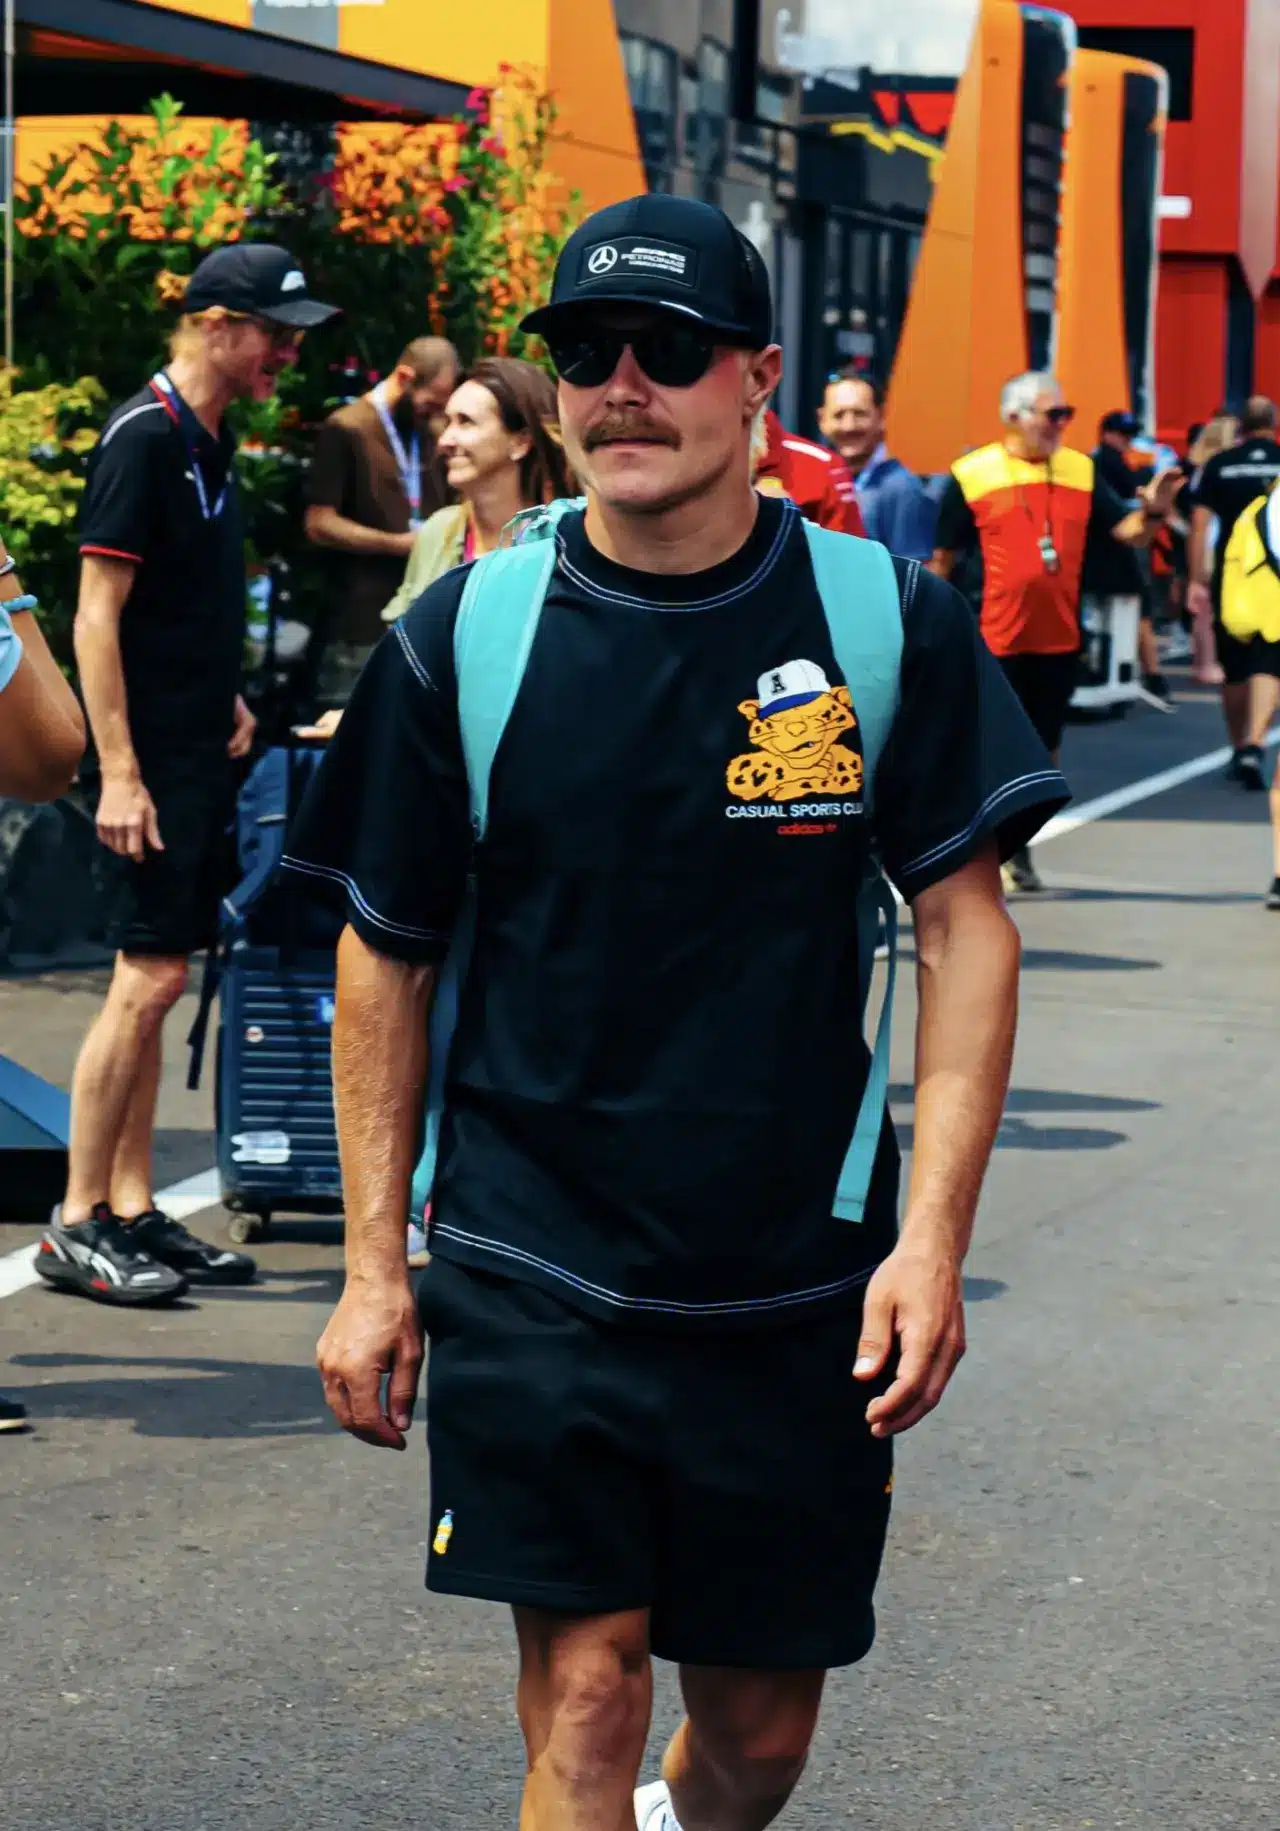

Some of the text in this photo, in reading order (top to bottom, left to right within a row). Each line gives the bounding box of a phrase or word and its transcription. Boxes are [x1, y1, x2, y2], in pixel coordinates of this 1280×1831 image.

[725, 802, 864, 818] CASUAL SPORTS CLU
